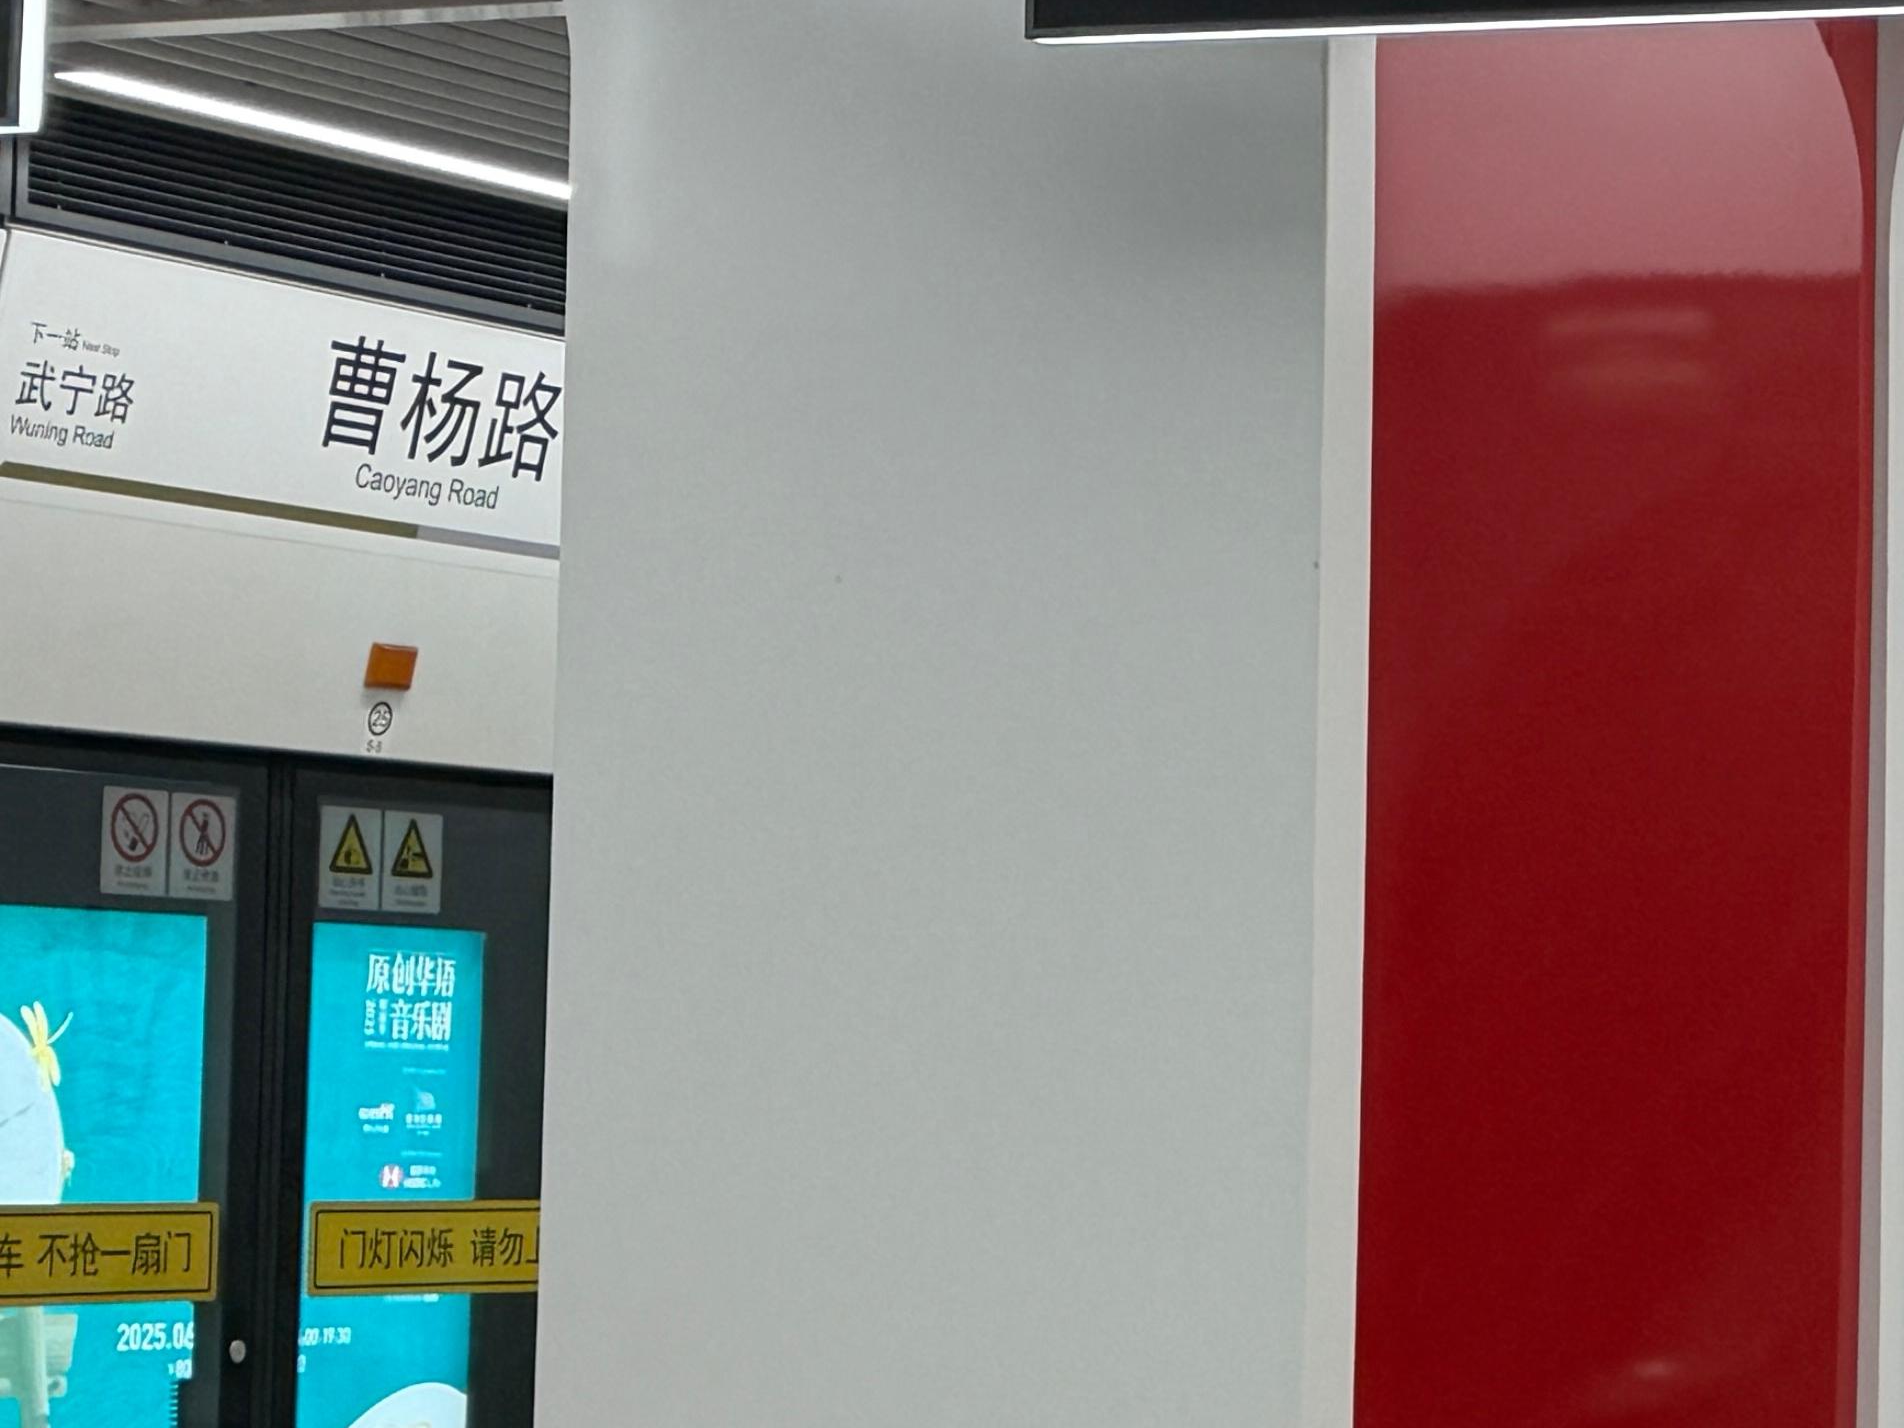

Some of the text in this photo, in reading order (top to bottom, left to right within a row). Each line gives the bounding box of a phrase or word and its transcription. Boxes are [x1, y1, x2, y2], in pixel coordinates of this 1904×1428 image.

[31, 321, 81, 351] 下一站
[15, 359, 135, 424] 武宁路
[321, 334, 563, 482] 曹杨路
[9, 413, 115, 449] Wuning Road
[354, 462, 500, 510] Caoyang Road
[366, 951, 456, 998] 原创华语
[389, 998, 453, 1042] 音乐剧
[37, 1230, 192, 1277] 不抢一扇门
[340, 1227, 454, 1269] 门灯闪烁
